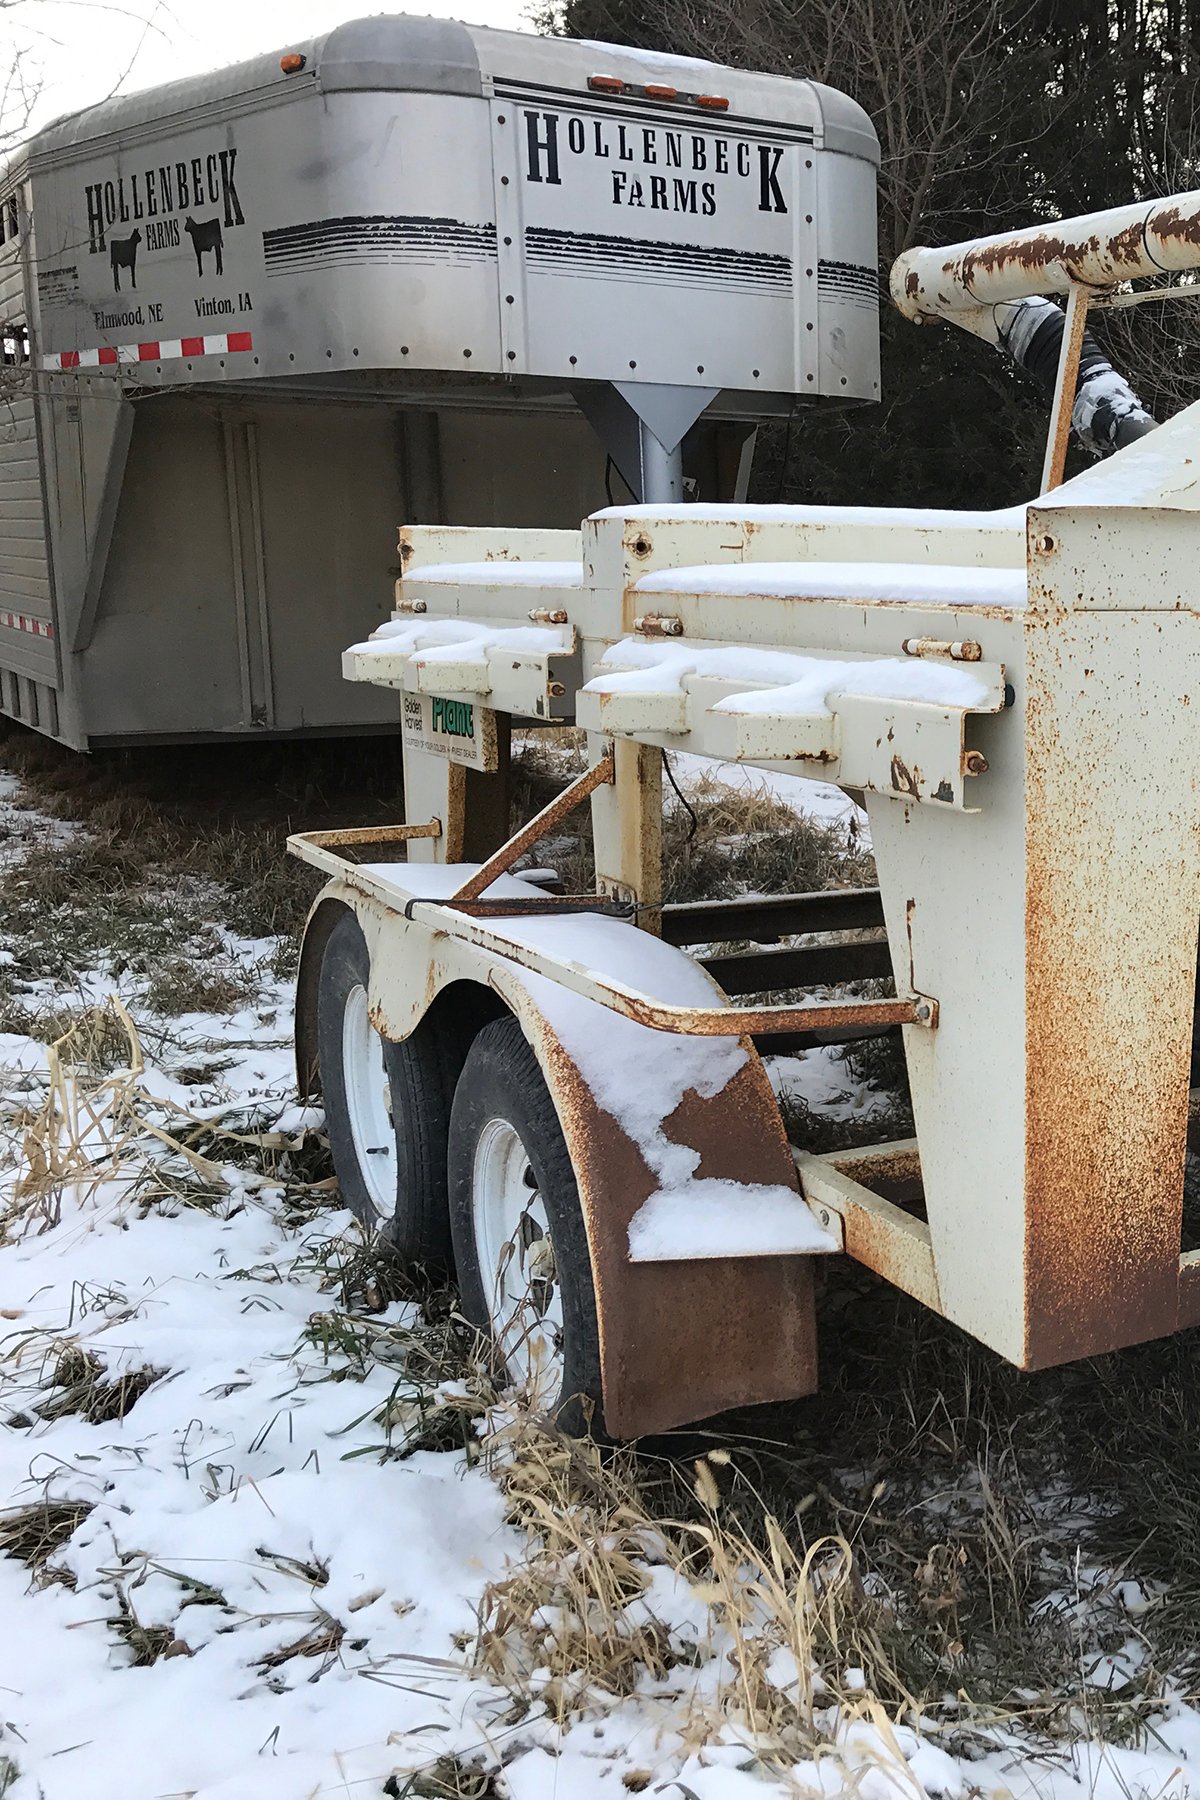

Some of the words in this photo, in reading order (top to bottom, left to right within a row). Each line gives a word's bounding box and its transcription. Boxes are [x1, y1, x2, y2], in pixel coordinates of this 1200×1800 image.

[523, 110, 788, 214] HOLLENBECK
[85, 148, 245, 254] HOLLENBECK
[611, 170, 716, 216] FARMS
[145, 218, 181, 251] FARMS
[94, 307, 146, 330] Elmwood,
[148, 303, 163, 323] NE
[194, 295, 235, 318] Vinton,
[238, 292, 253, 312] IA
[404, 697, 422, 714] Golden
[432, 697, 474, 739] Plant
[404, 714, 423, 731] Harvest
